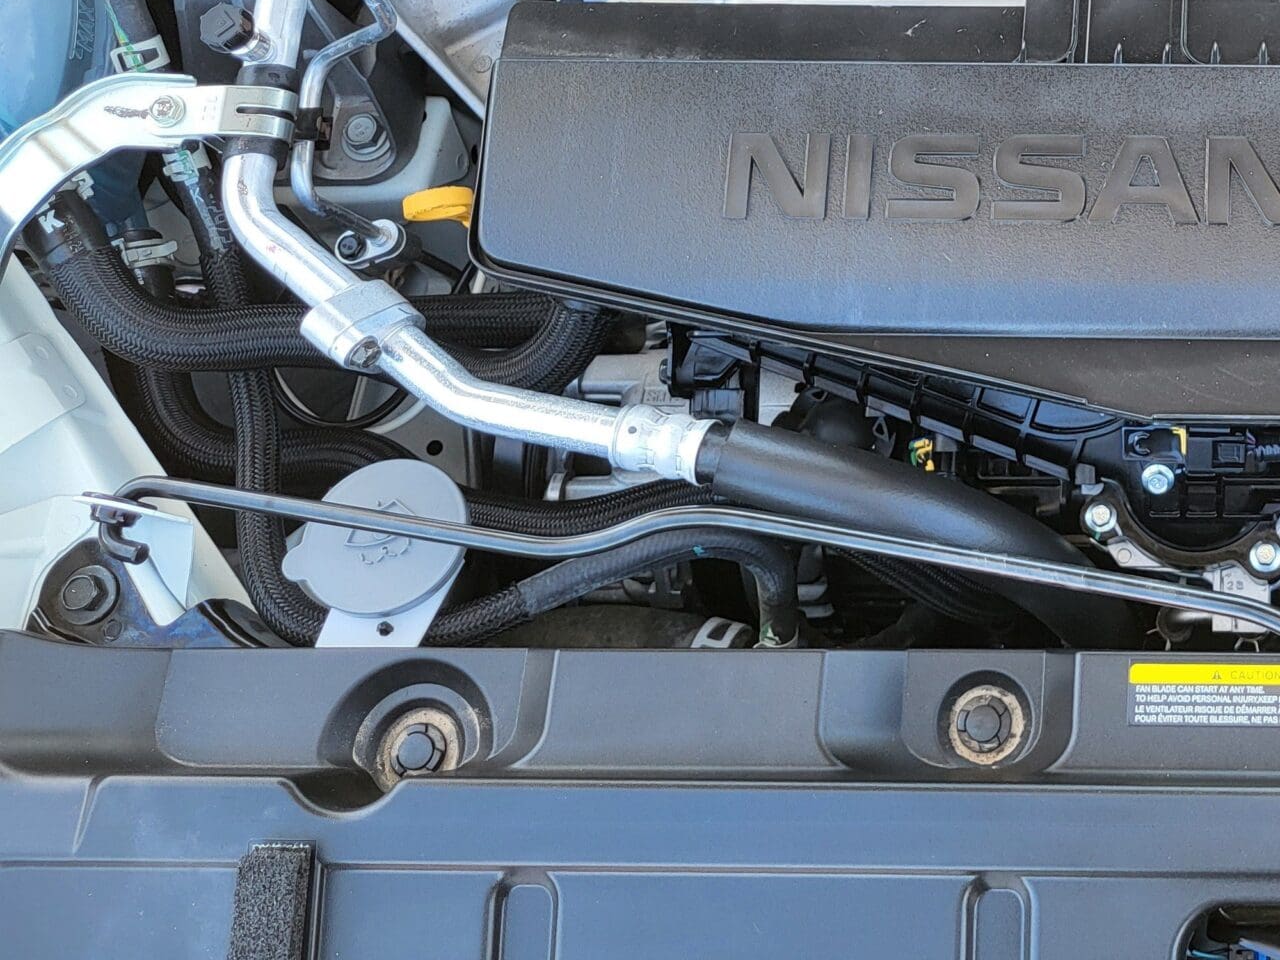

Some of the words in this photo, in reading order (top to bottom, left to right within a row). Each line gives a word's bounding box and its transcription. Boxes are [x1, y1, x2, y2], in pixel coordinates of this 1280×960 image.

[1136, 685, 1150, 693] FAN
[1152, 685, 1176, 693] BLADE
[1195, 706, 1223, 714] RISQUE
[1236, 704, 1276, 714] DÉMARRER
[1158, 714, 1183, 723] ÉVITER
[1210, 716, 1250, 724] BLESSURE,
